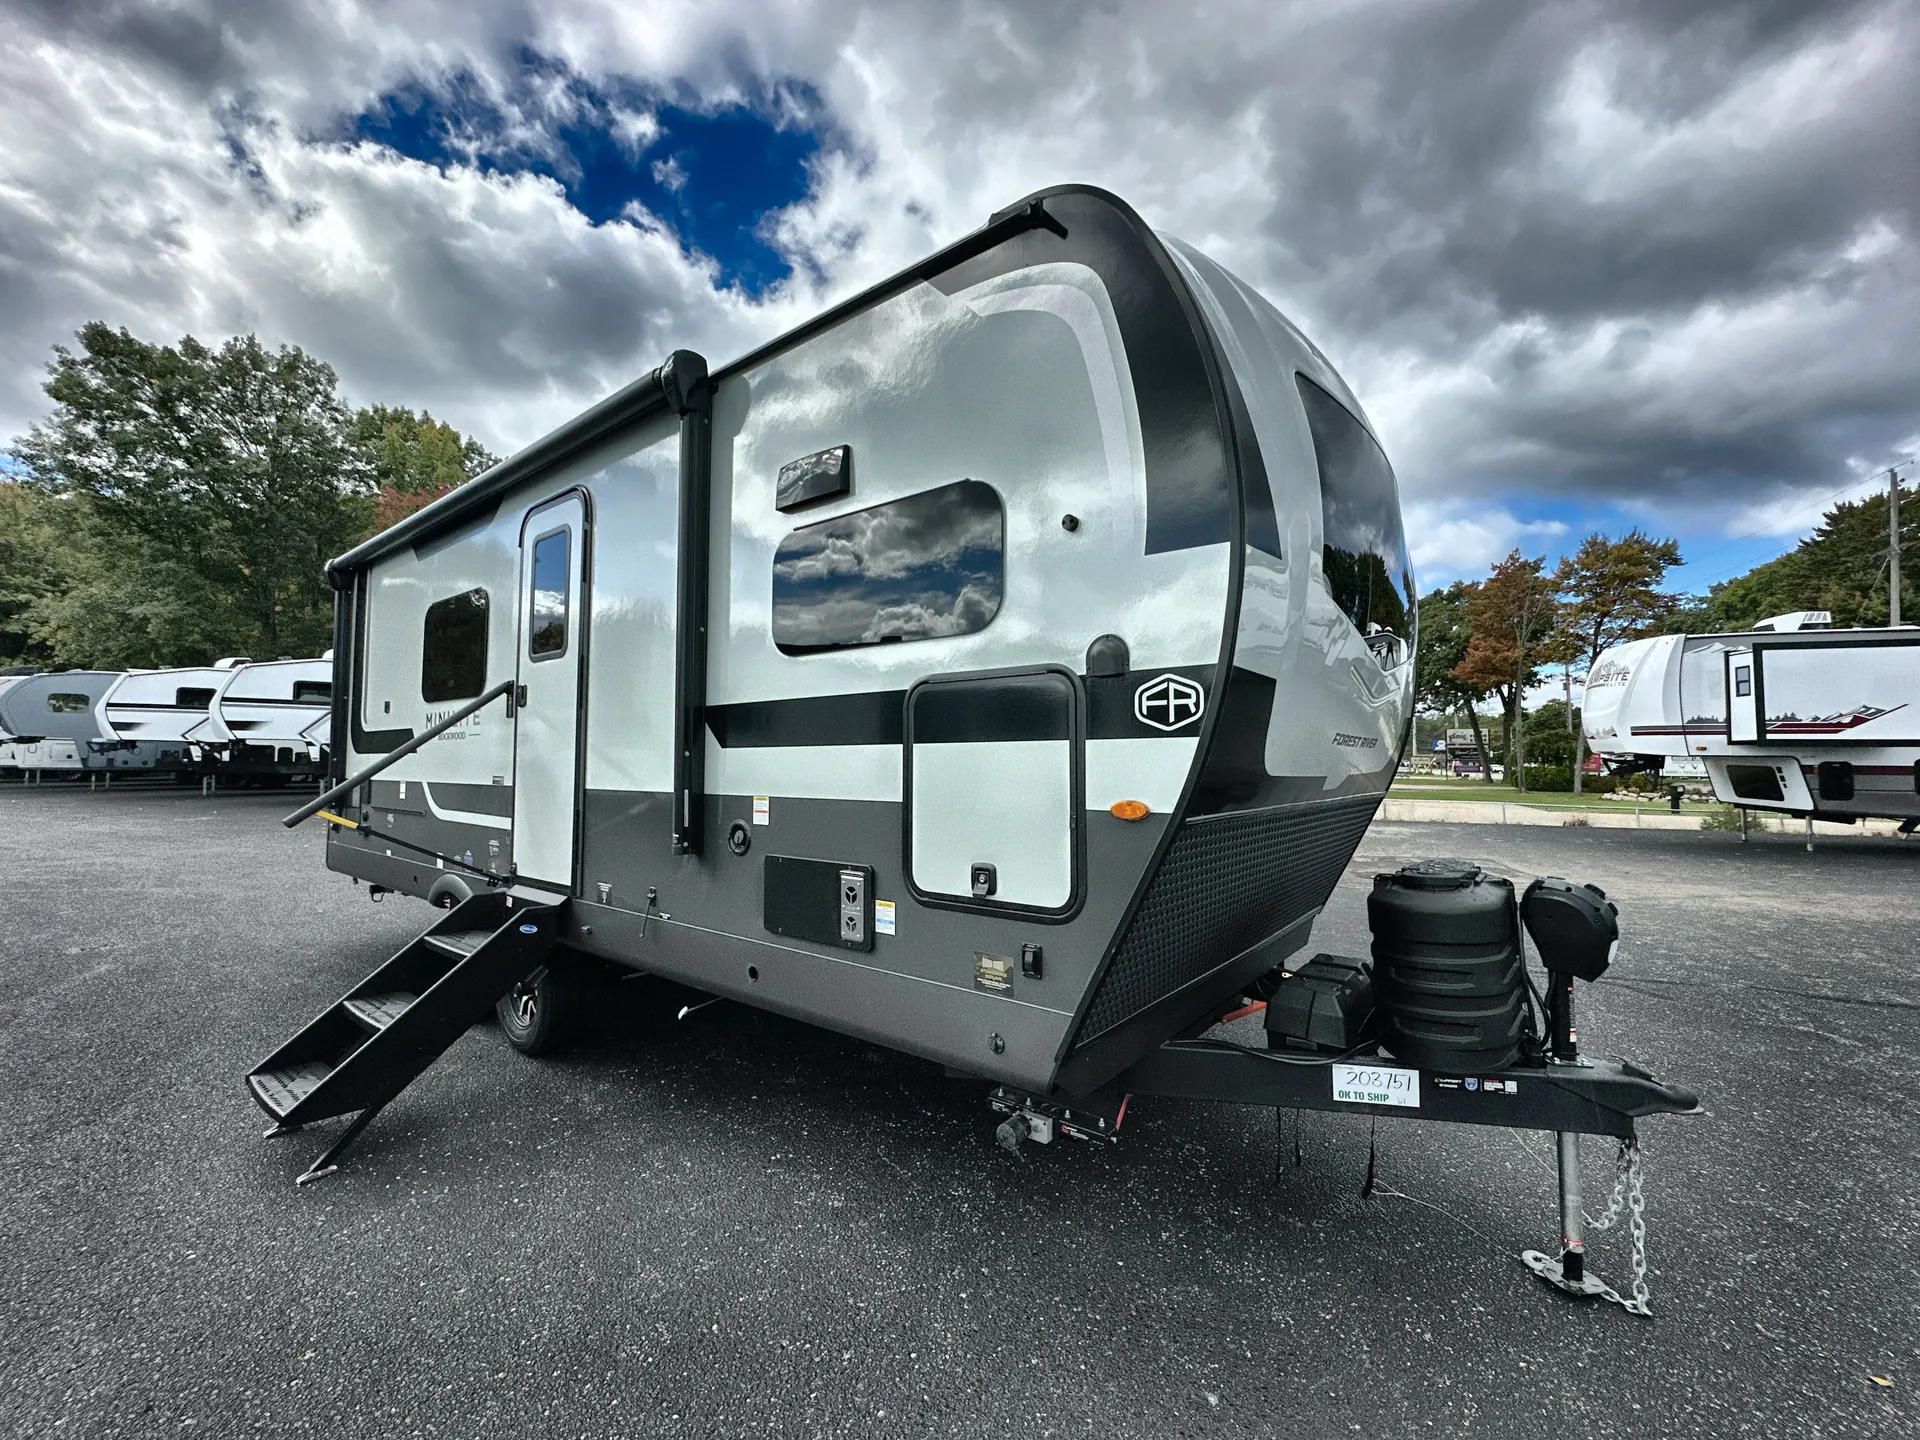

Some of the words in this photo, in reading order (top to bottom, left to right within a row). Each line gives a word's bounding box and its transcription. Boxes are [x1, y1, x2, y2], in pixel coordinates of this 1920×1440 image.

[438, 732, 466, 741] ROCKWOOD
[1332, 732, 1362, 748] FOREST
[1361, 738, 1378, 748] RIVER
[1346, 1070, 1411, 1092] 203751
[1338, 1089, 1351, 1099] OK
[1353, 1091, 1365, 1101] TO
[1367, 1092, 1390, 1103] SHIP
